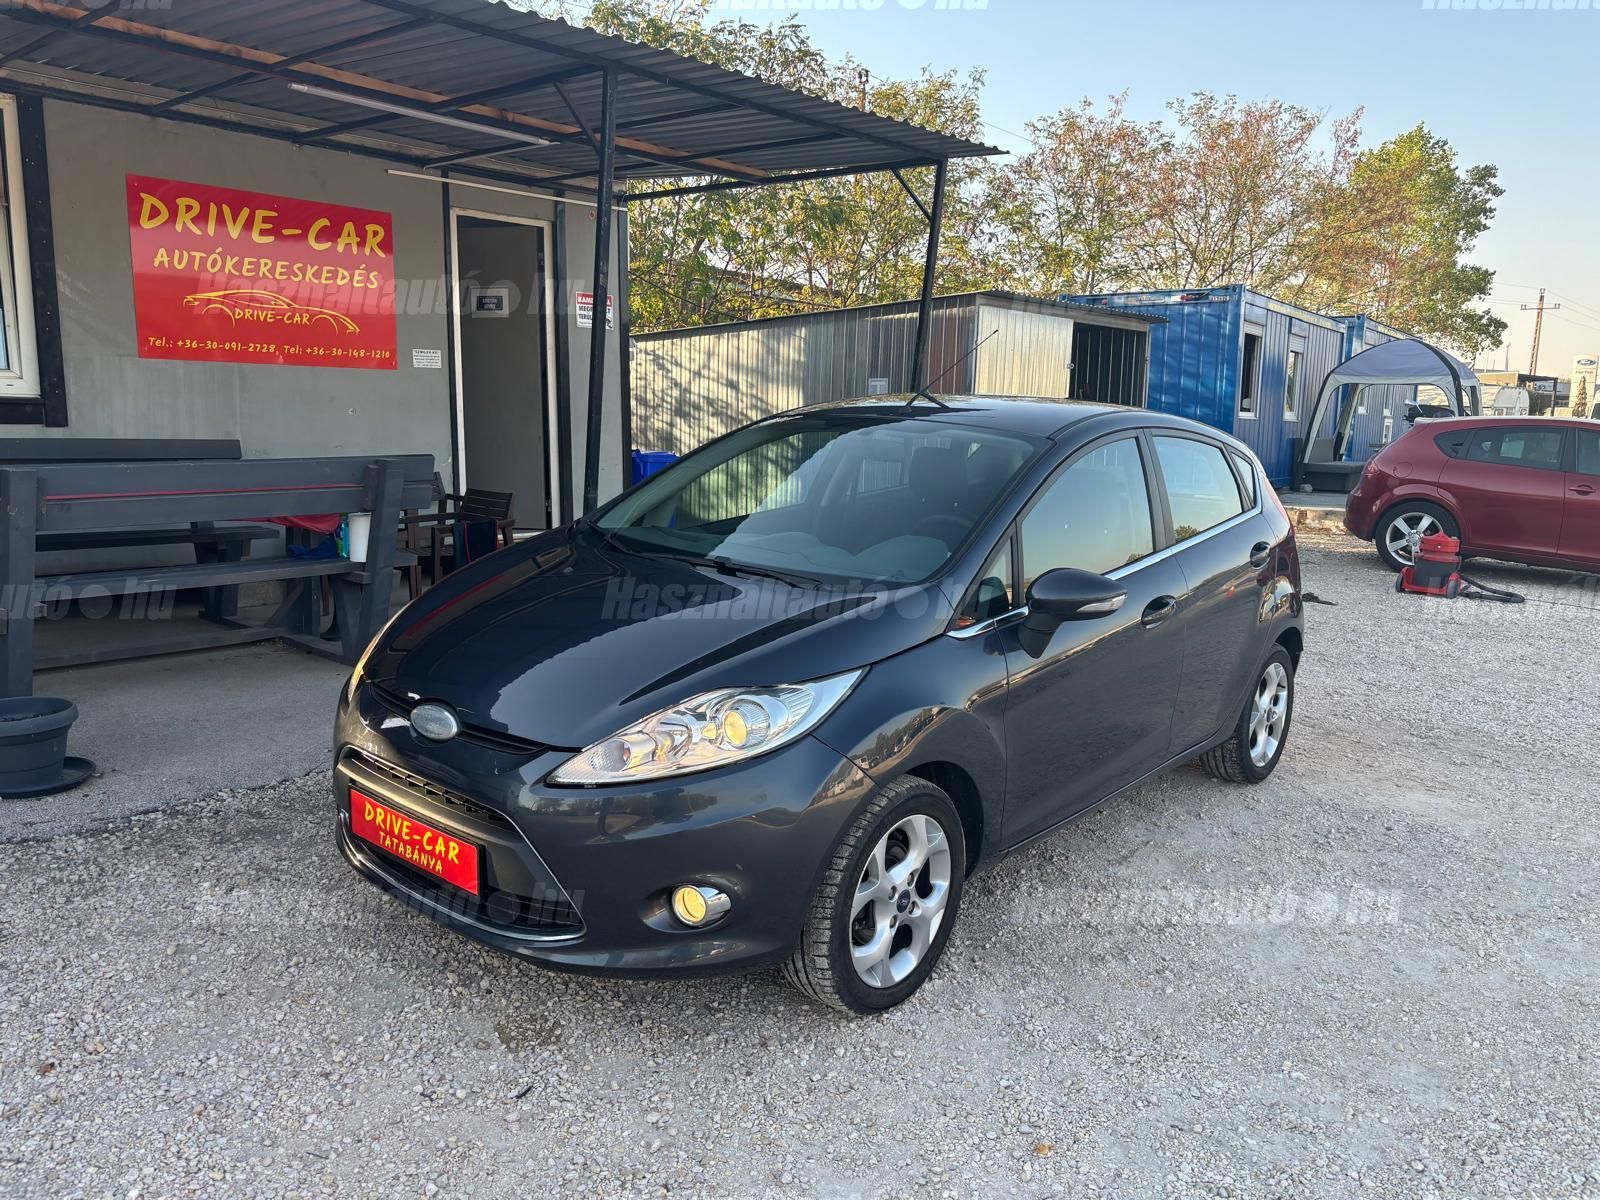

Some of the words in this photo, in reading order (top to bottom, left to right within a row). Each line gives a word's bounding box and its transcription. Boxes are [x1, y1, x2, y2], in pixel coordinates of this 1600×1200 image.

[139, 192, 386, 258] DRIVE-CAR
[153, 246, 379, 289] AUTÓKERESKEDÉS
[234, 307, 310, 325] DRIVE-CAR
[148, 336, 173, 347] Tel.:
[284, 345, 303, 354] Tel:
[364, 801, 459, 864] DRIVE-CAR
[379, 831, 443, 874] TATABÁNYA
